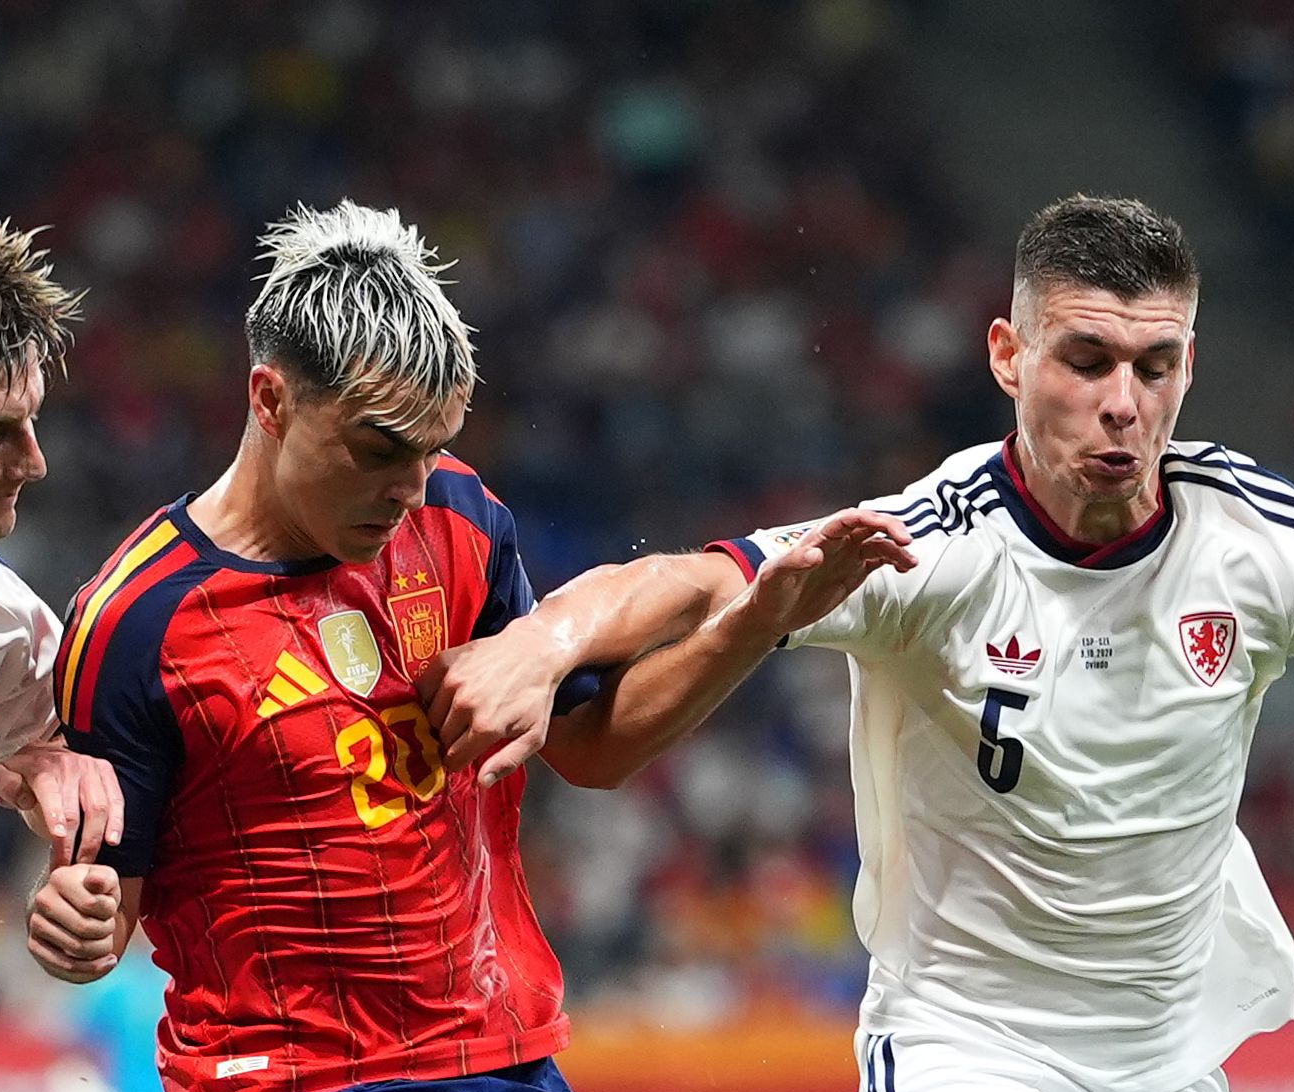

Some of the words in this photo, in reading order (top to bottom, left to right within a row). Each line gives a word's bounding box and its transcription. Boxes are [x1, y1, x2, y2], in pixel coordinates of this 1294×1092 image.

[346, 663, 369, 677] FIFA
[335, 701, 446, 831] 20
[977, 687, 1029, 794] 5
